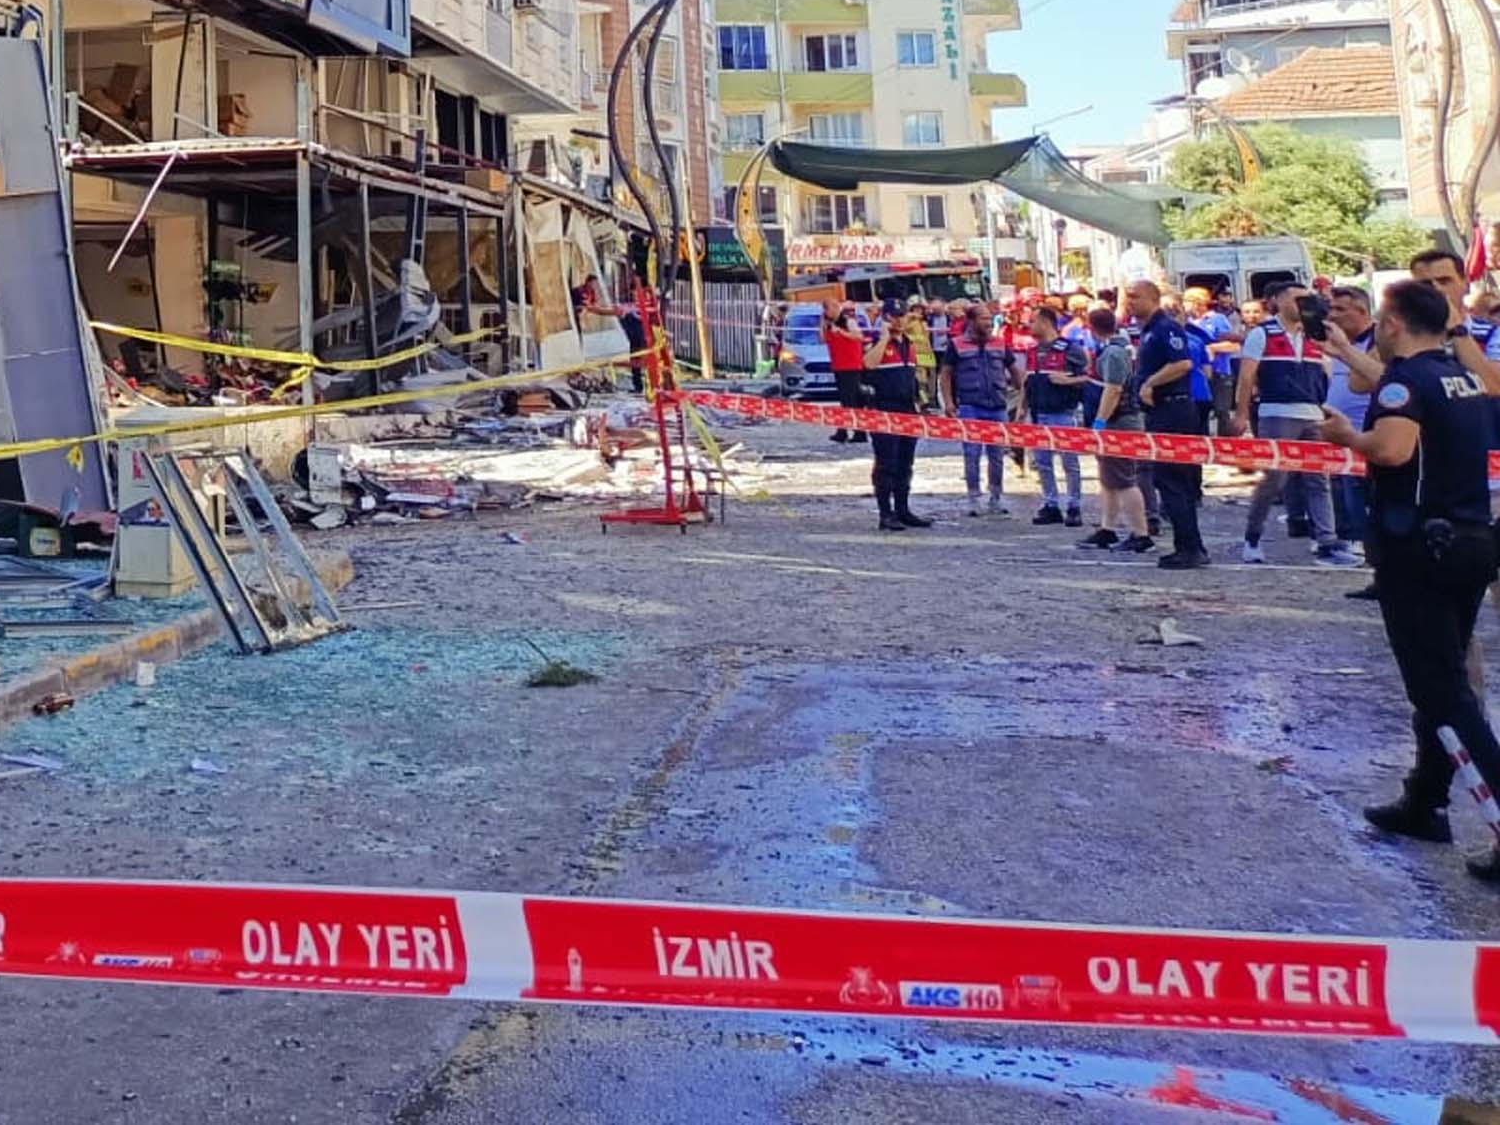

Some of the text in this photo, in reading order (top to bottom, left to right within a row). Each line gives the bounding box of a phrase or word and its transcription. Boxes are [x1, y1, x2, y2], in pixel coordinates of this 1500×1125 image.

[241, 915, 454, 971] OLAY YERİ
[652, 926, 779, 981] İZMİR
[906, 986, 999, 1009] AKS 110
[1087, 957, 1370, 1006] OLAY YERİ
